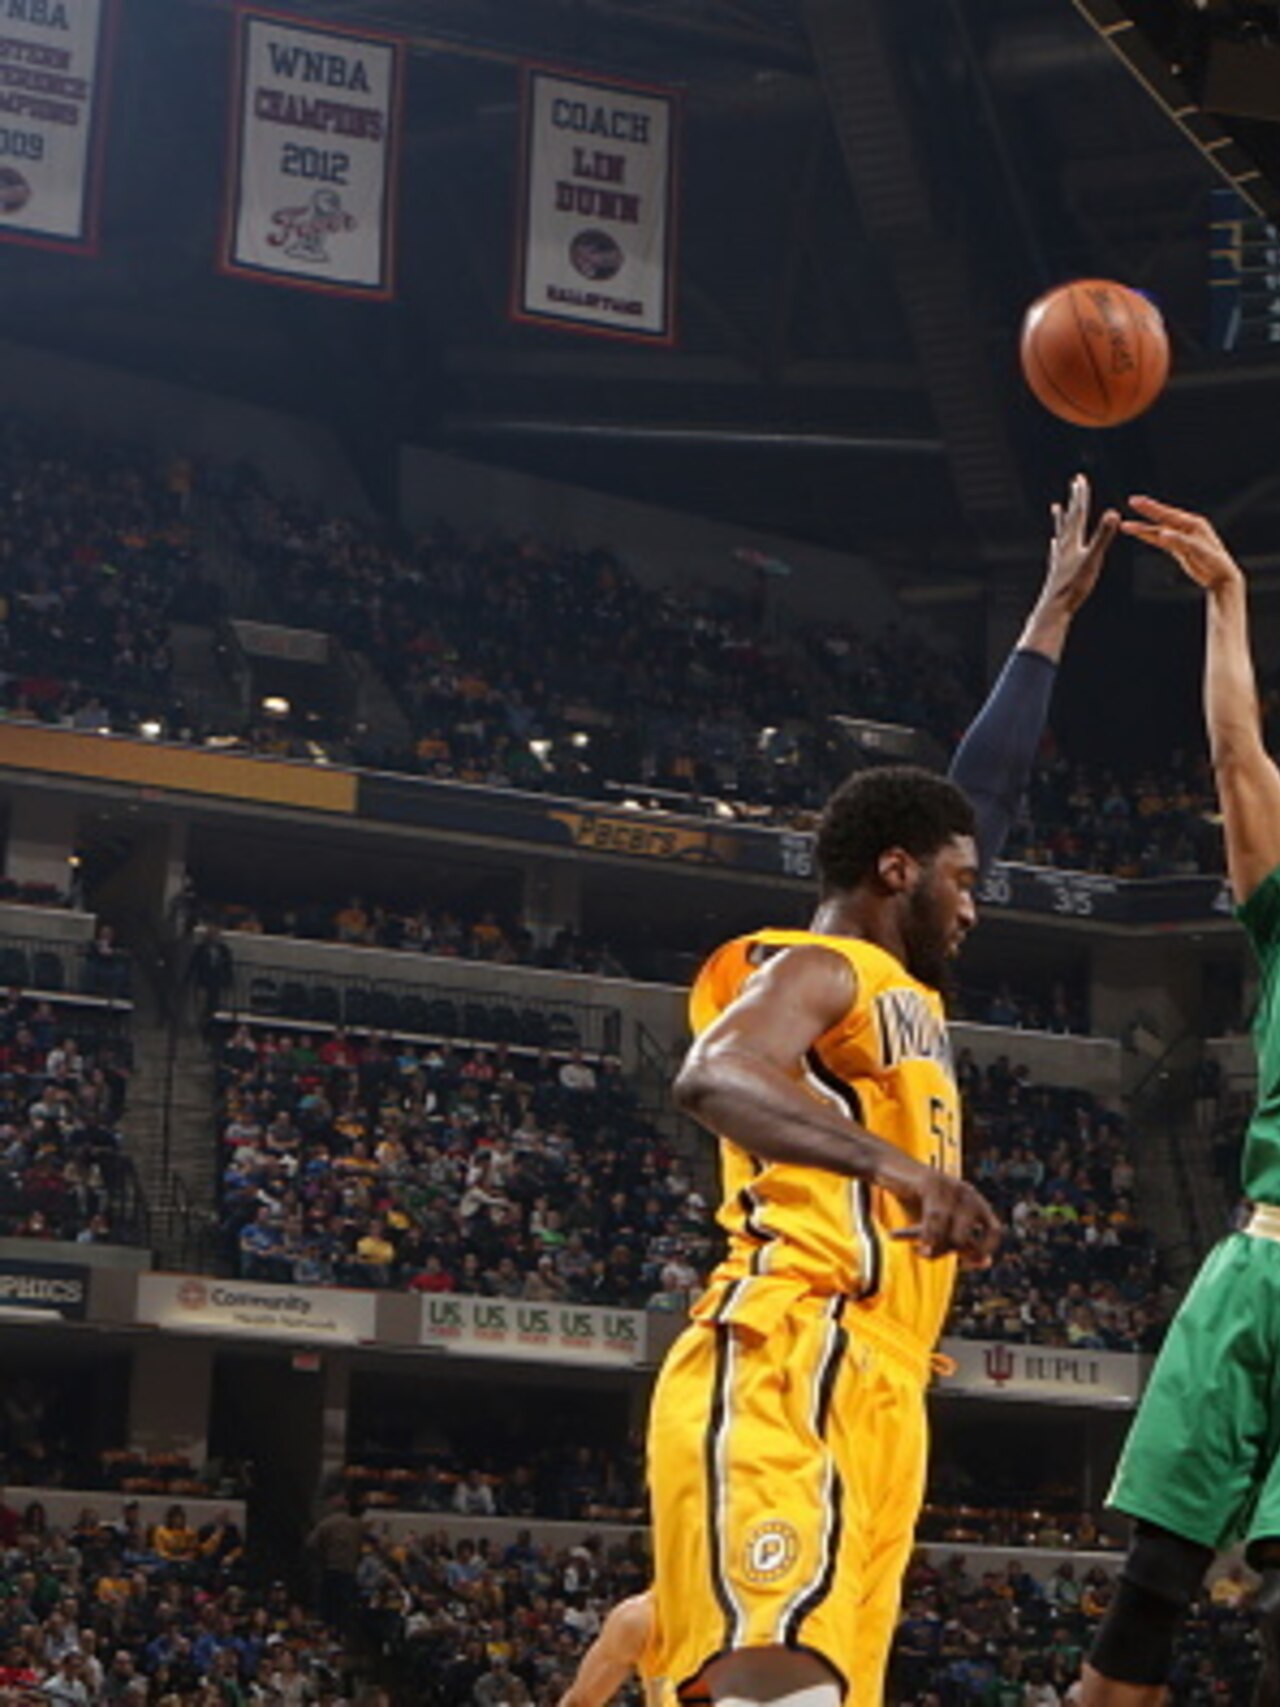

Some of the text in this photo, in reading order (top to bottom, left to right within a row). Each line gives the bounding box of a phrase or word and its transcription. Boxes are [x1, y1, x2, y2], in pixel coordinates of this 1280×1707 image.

[268, 43, 371, 92] WNBA
[254, 87, 382, 141] CHAMPIONS
[552, 98, 651, 143] COACH
[281, 142, 350, 185] 2012
[573, 147, 626, 184] LIN
[556, 181, 641, 223] DUNN
[1053, 887, 1094, 916] 35
[211, 1288, 311, 1316] Community
[1025, 1357, 1099, 1385] IUPUI
